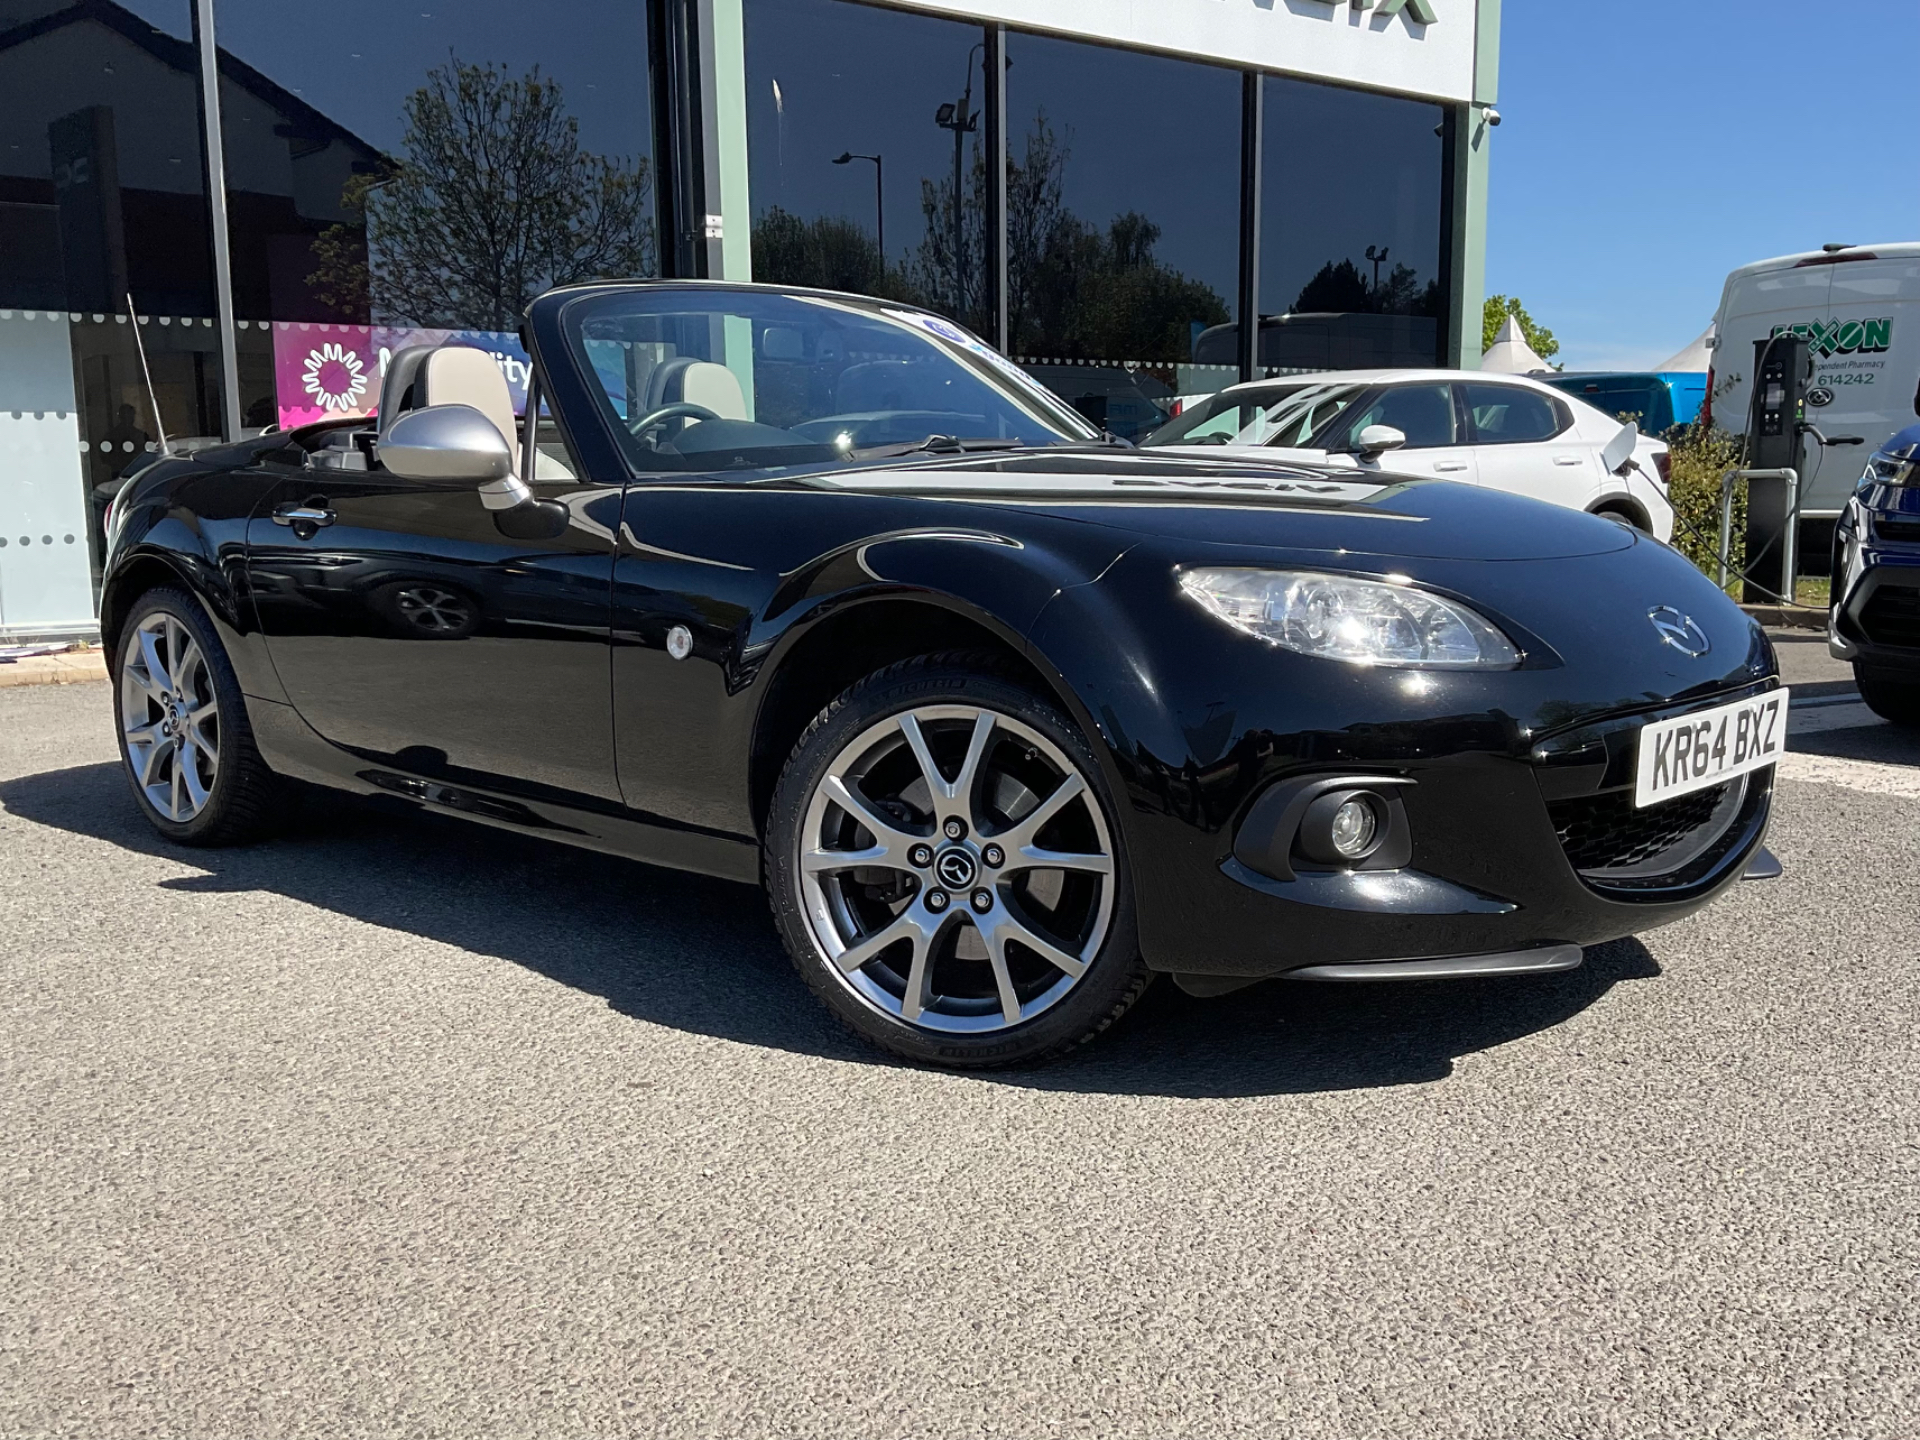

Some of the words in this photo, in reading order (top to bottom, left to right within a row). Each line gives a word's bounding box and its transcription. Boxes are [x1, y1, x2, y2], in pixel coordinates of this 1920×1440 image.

[1848, 360, 1886, 370] Pharmacy
[1818, 373, 1875, 386] 614242
[1652, 714, 1728, 792] KR64
[1733, 699, 1780, 765] BXZ
